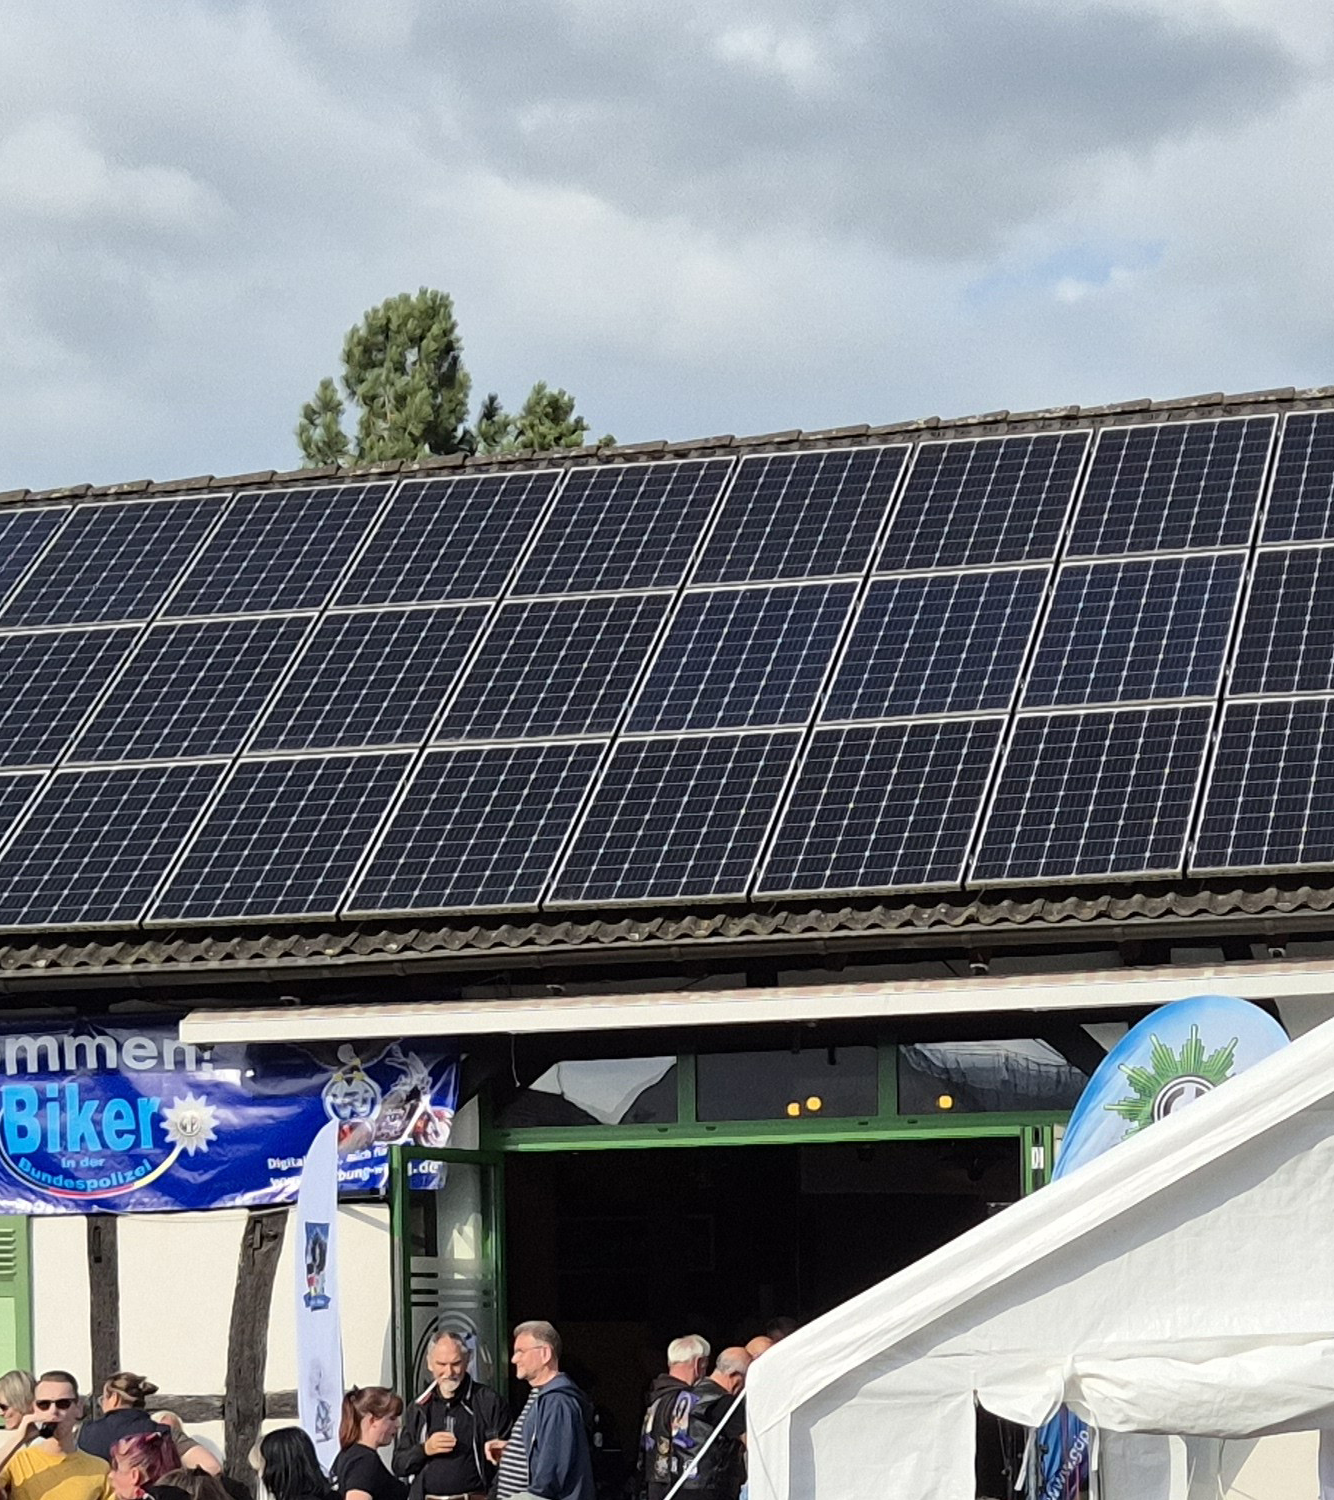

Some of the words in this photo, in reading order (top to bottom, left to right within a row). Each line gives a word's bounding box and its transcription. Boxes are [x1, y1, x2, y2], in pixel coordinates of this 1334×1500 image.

[1, 1083, 161, 1155] Biker
[18, 1157, 153, 1192] Bundespolizei
[61, 1157, 76, 1168] in
[80, 1157, 106, 1167] der
